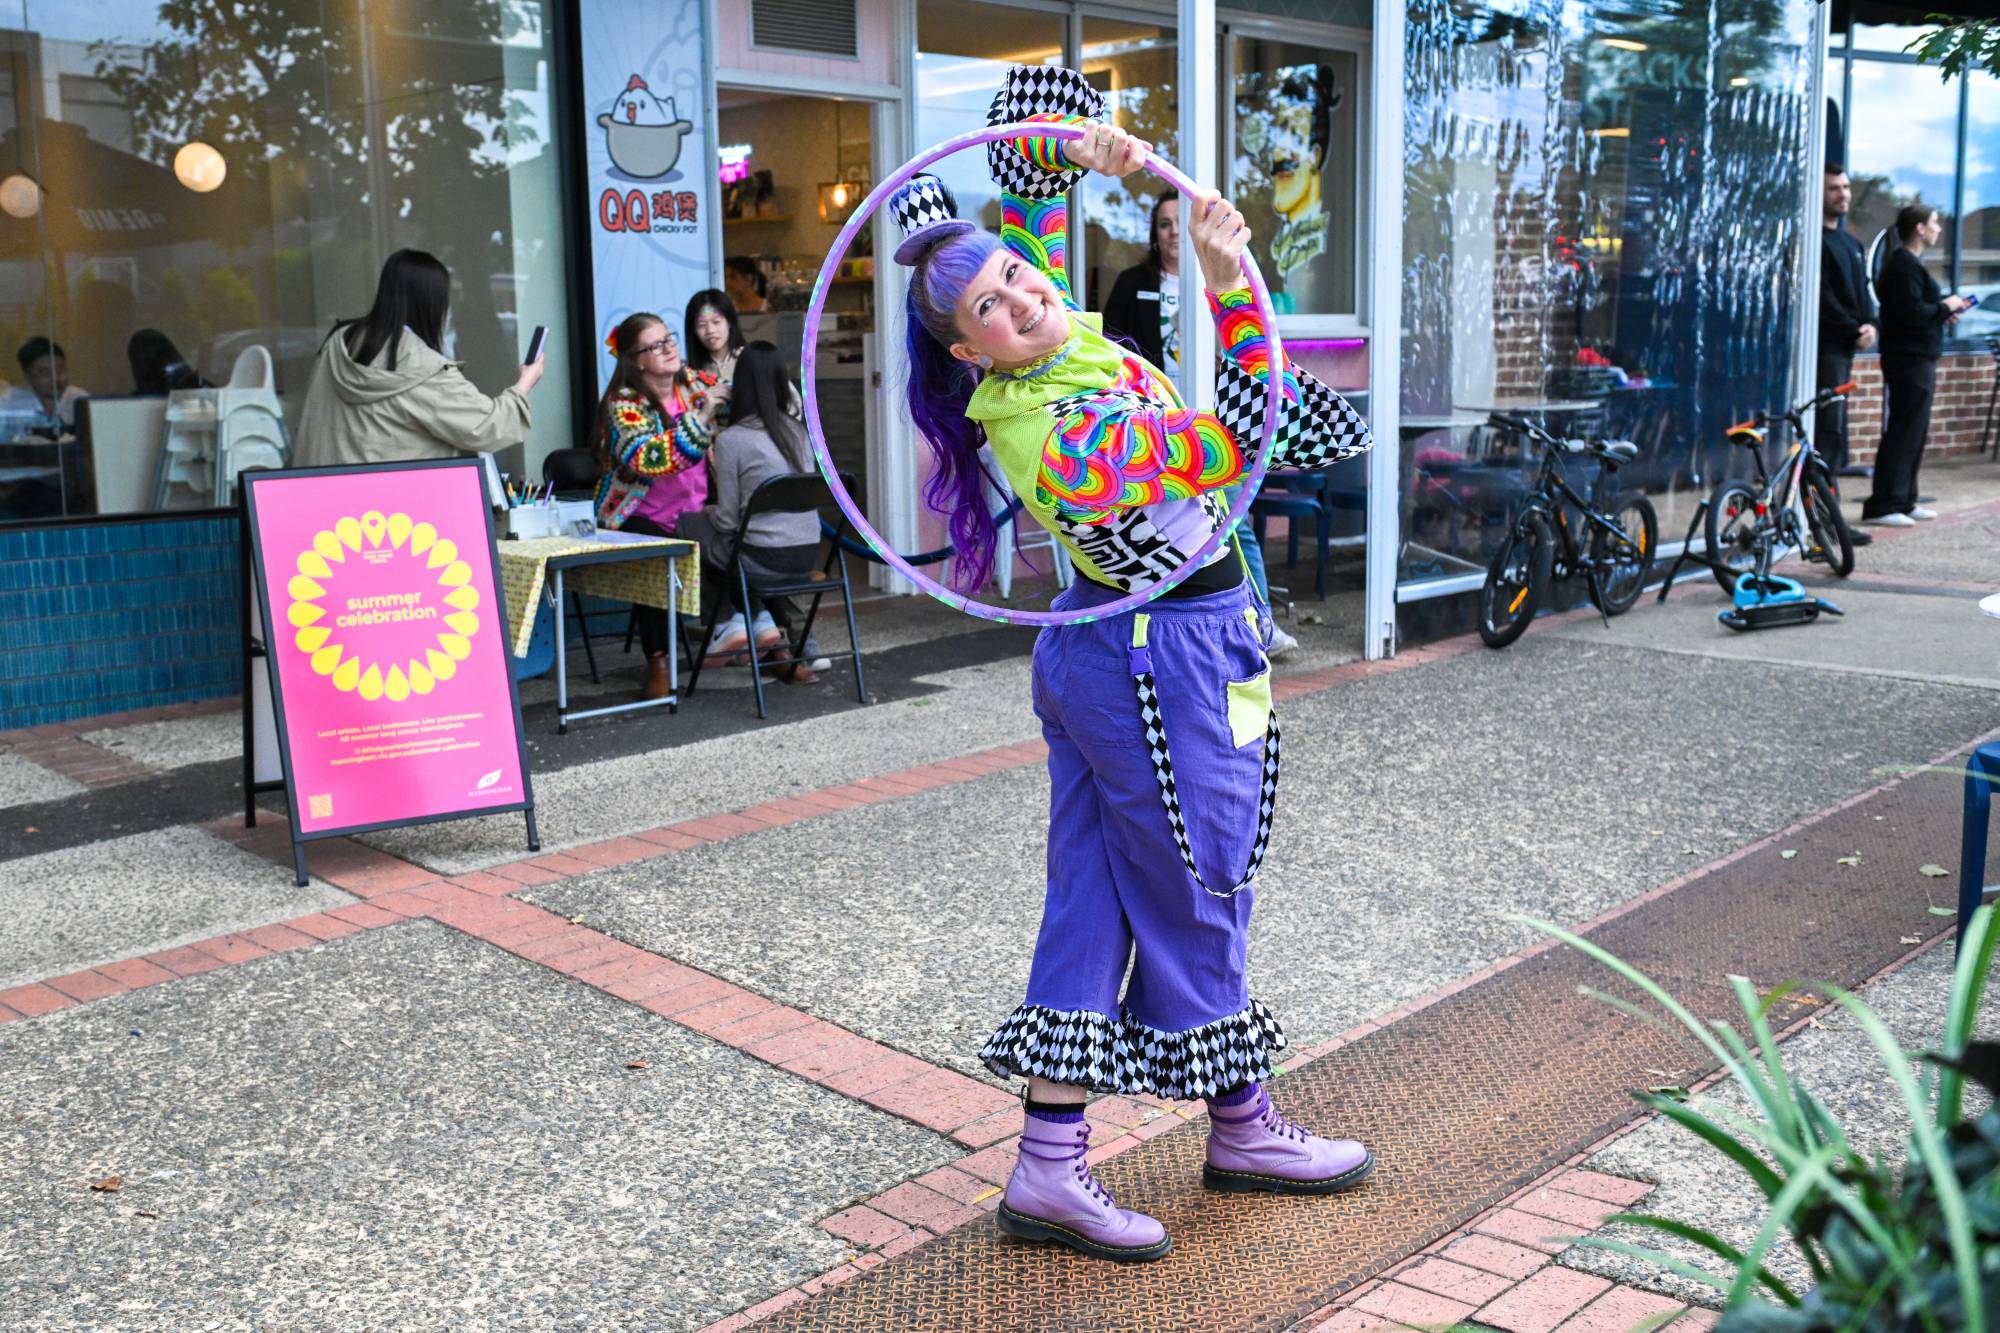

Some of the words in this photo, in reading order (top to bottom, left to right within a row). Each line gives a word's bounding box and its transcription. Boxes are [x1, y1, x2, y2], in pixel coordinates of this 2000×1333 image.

[600, 187, 651, 234] QQ
[682, 224, 698, 233] POT
[347, 592, 422, 611] summer
[336, 605, 437, 627] celebration
